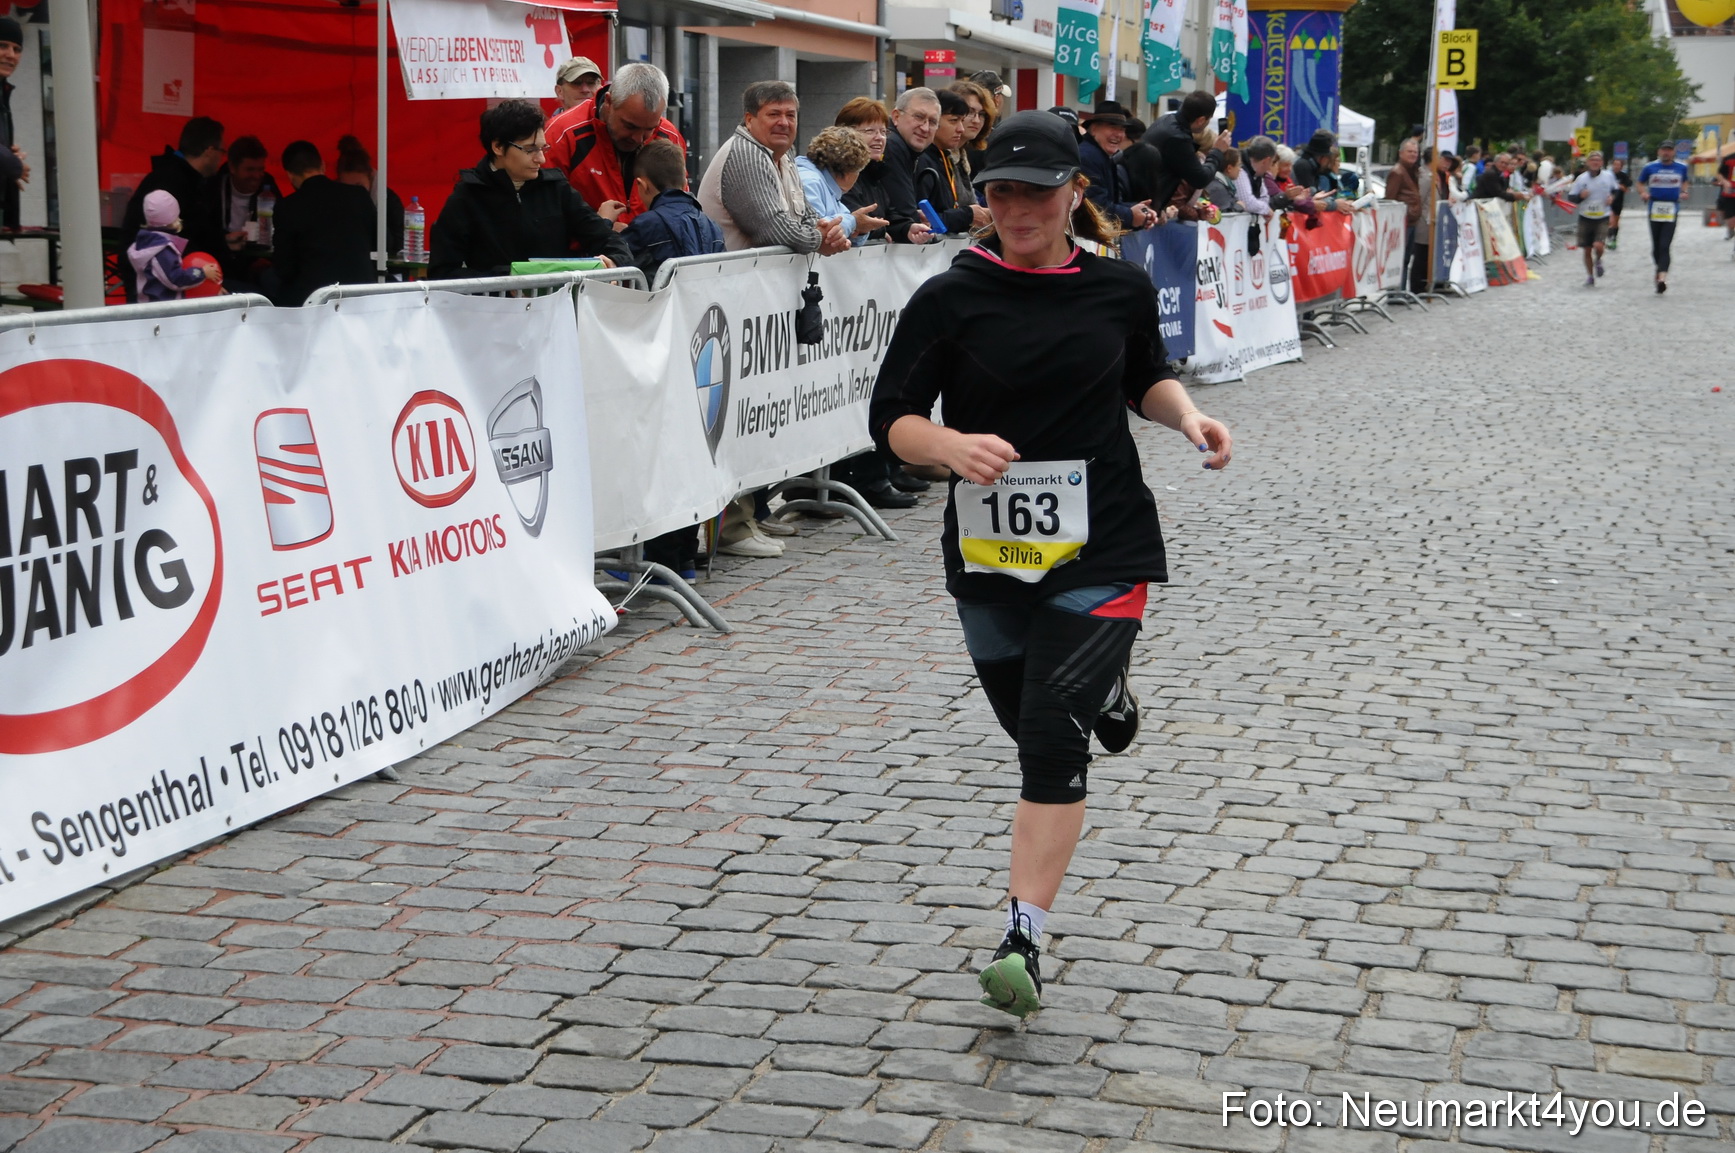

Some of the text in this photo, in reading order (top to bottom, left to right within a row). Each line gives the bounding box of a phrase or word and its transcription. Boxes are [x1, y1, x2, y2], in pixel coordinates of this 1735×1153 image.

[1441, 33, 1472, 44] Block
[410, 68, 438, 83] LASS
[443, 68, 467, 83] DICH
[1446, 48, 1466, 76] B
[1577, 135, 1586, 148] C
[690, 309, 730, 361] BMW
[740, 311, 791, 379] BMW
[736, 393, 792, 438] Weniger
[794, 373, 846, 422] Verbrauch.
[406, 417, 470, 483] KIA
[143, 463, 159, 506] &
[1000, 474, 1063, 486] Neumarkt
[963, 528, 969, 537] D
[981, 491, 1060, 536] 163
[387, 513, 507, 578] KIA MOTORS
[998, 546, 1043, 565] Silvia
[256, 555, 373, 618] SEAT
[31, 756, 215, 866] Sengenthal
[230, 735, 280, 793] Tel.
[278, 694, 384, 776] 09181/26
[385, 678, 429, 736] 80-0
